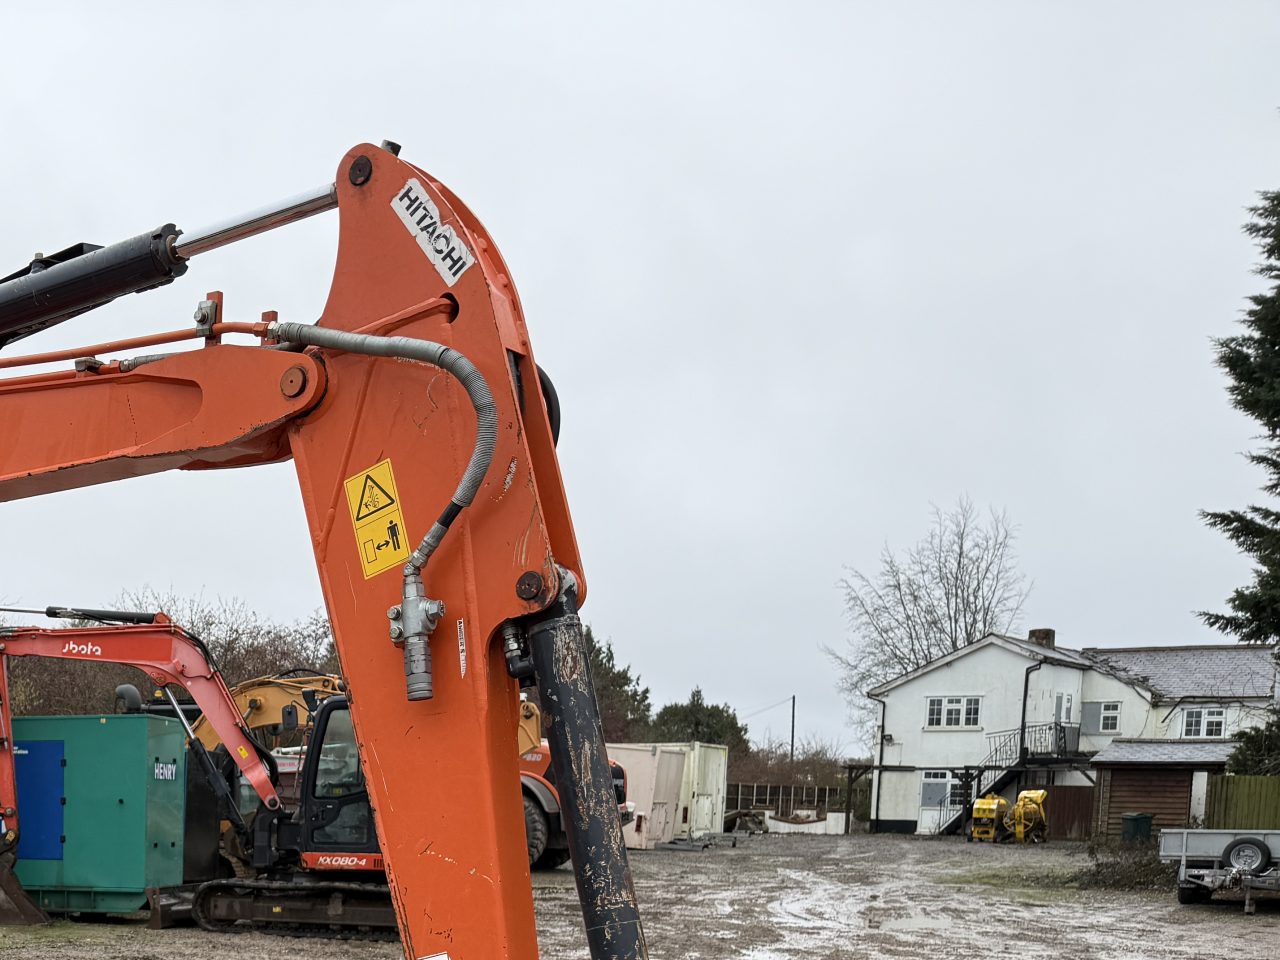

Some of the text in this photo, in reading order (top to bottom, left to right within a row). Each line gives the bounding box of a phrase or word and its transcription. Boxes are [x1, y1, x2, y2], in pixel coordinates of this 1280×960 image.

[399, 186, 466, 277] HITACHI
[154, 762, 176, 780] HENRY
[318, 856, 367, 866] KX080-4
